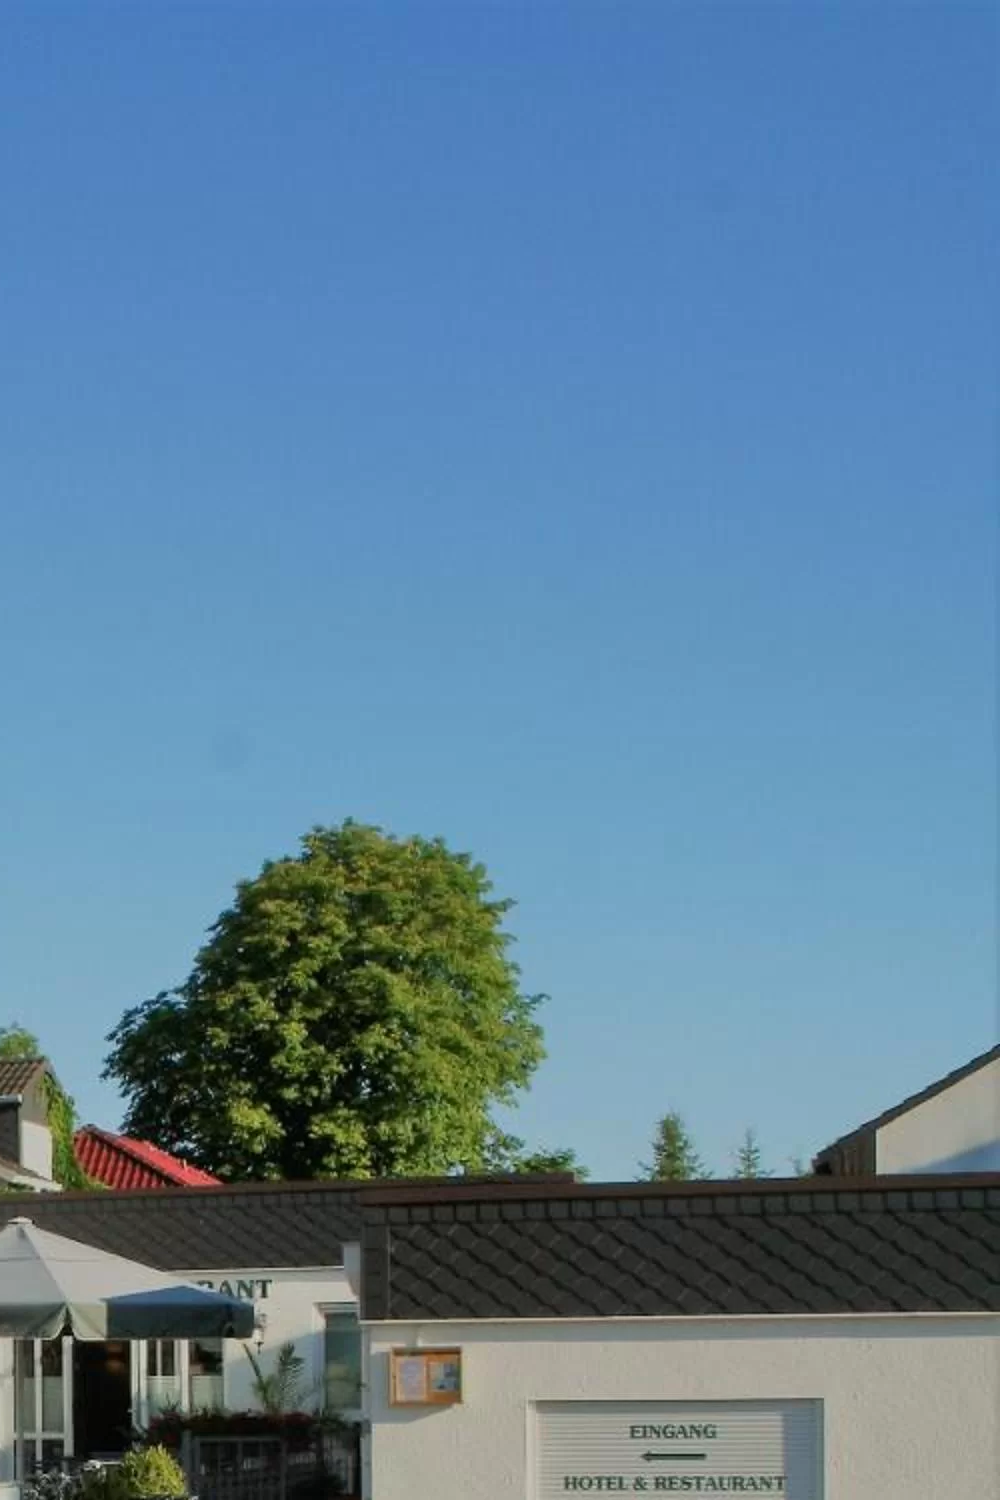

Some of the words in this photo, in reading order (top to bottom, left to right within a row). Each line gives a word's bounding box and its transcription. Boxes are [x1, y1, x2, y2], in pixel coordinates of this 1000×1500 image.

[629, 1423, 718, 1439] EINGANG
[564, 1475, 629, 1491] HOTEL
[632, 1475, 648, 1491] &
[653, 1475, 788, 1491] RESTAURANT
